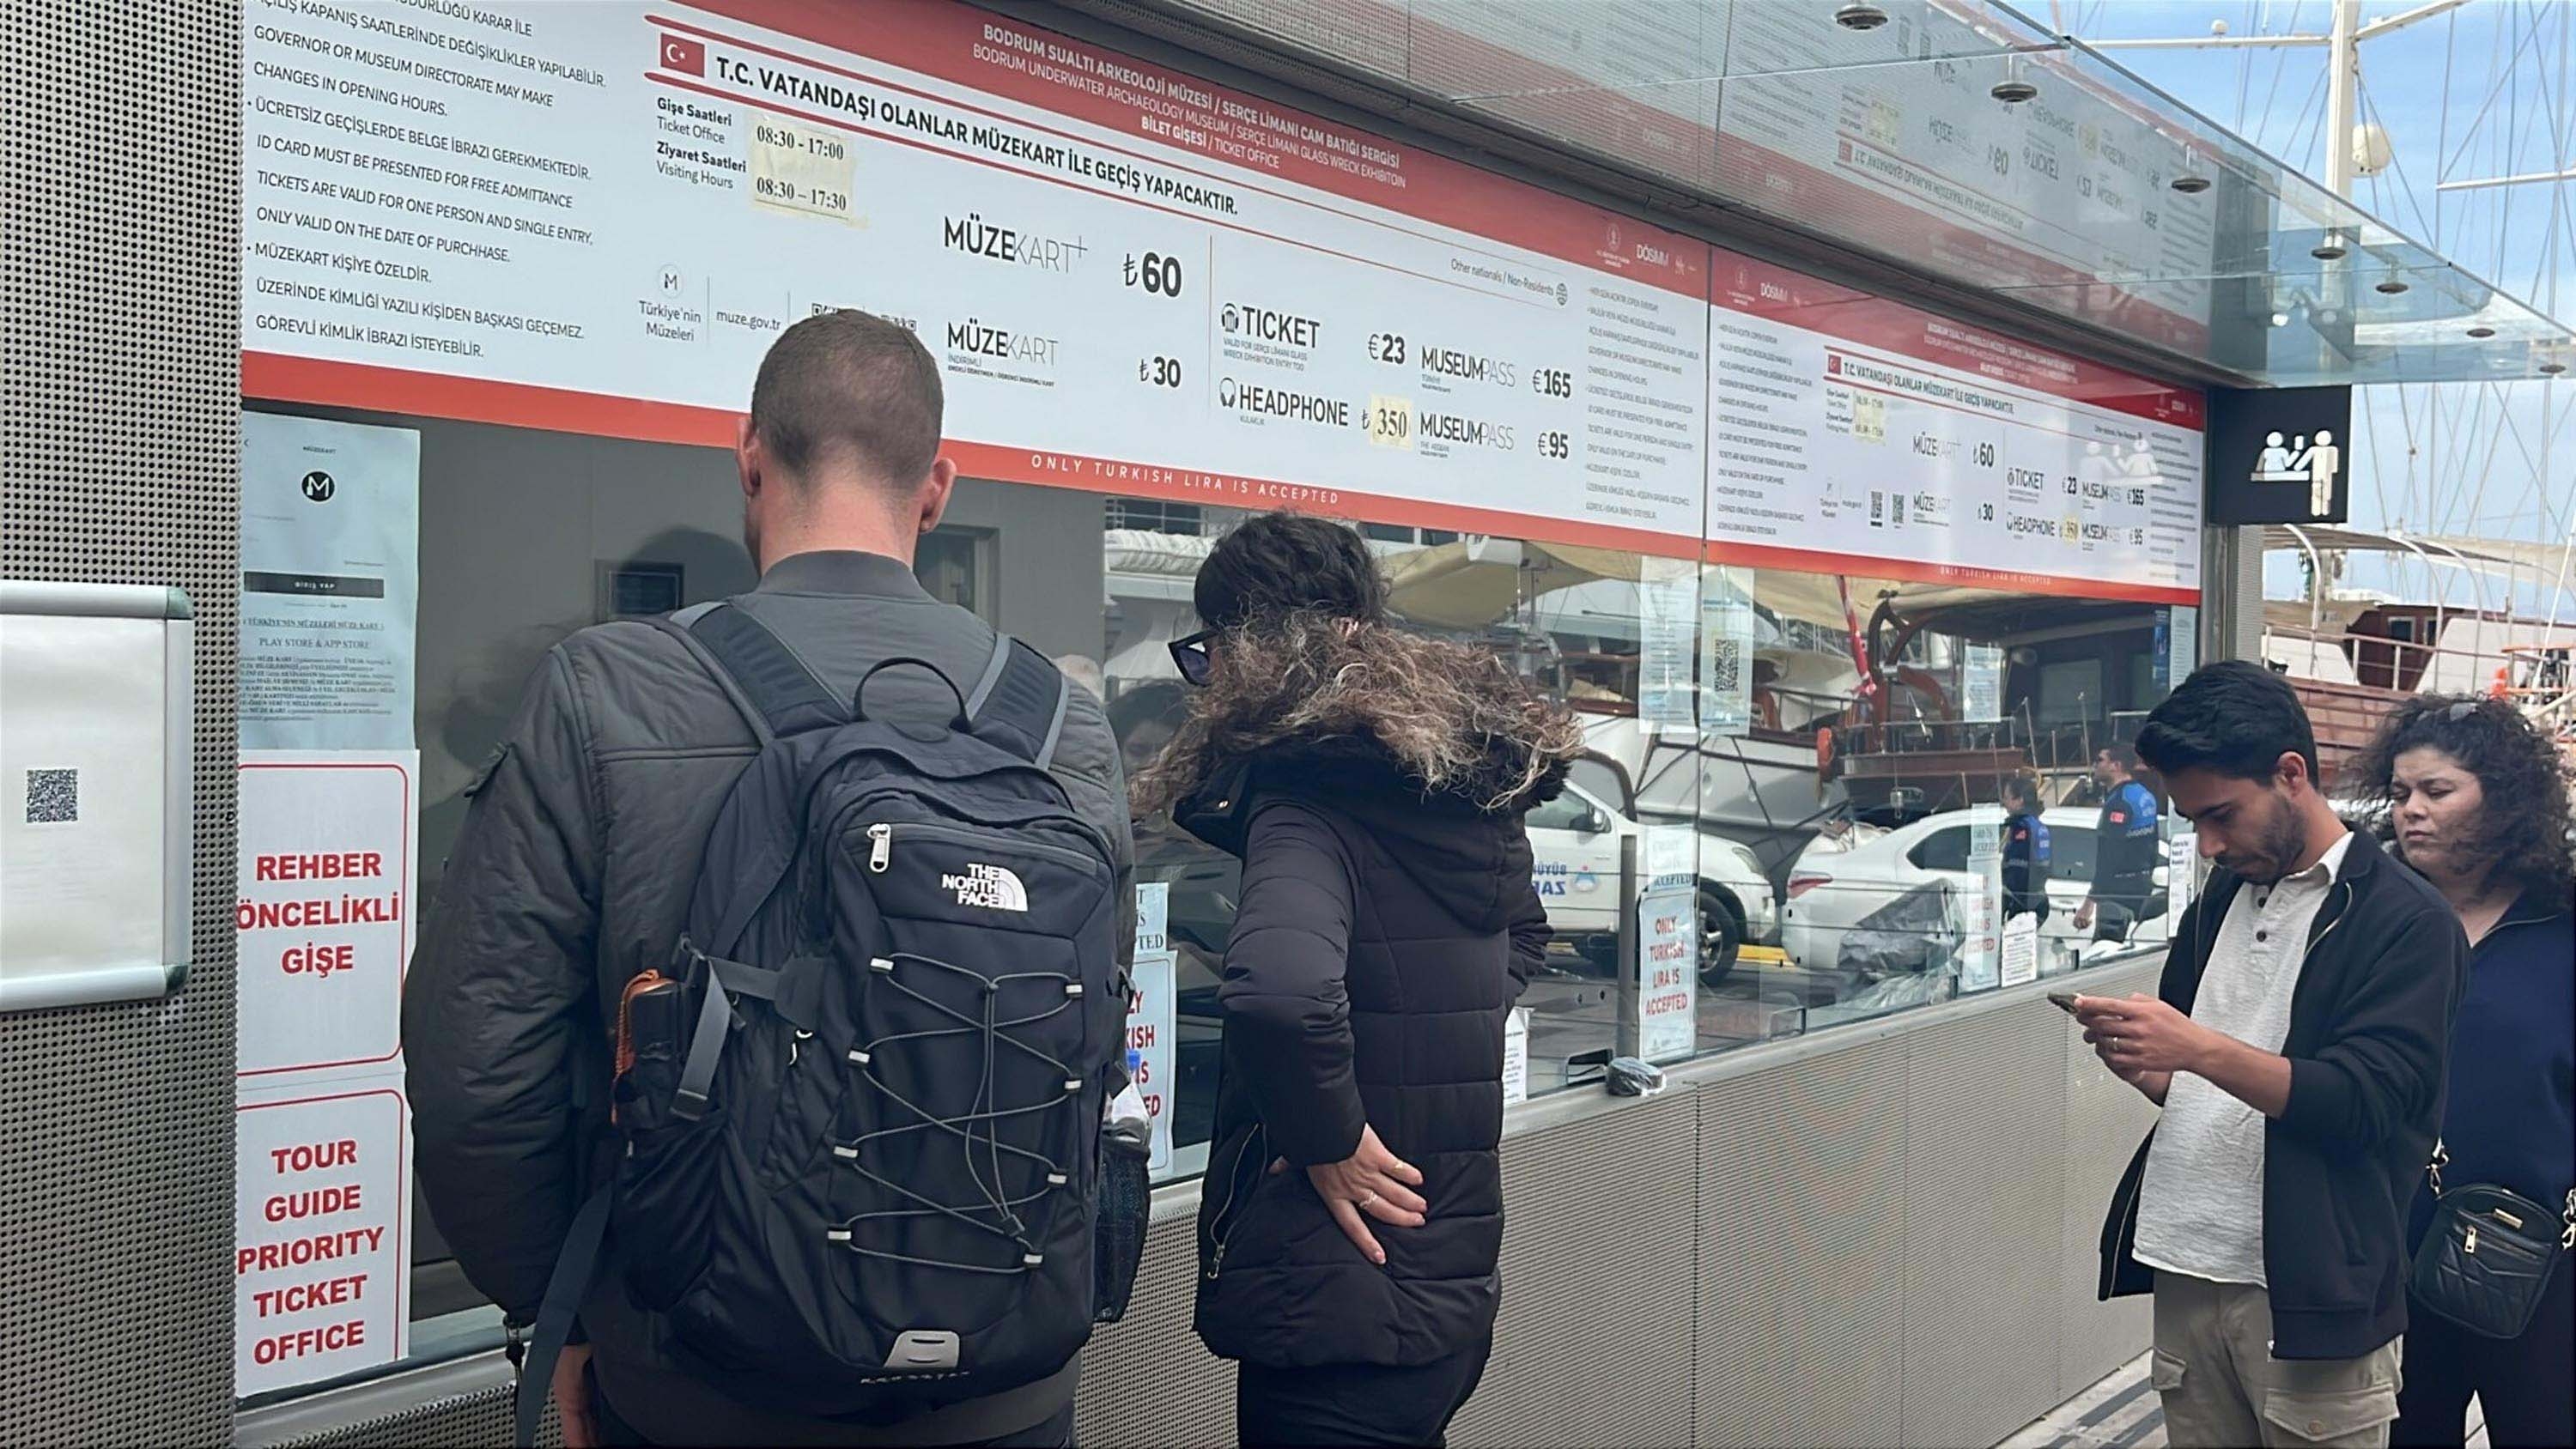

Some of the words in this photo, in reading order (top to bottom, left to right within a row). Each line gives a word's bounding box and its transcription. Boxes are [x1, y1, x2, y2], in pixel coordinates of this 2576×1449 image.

[472, 9, 512, 31] KARAR
[514, 18, 532, 37] İLE
[300, 0, 358, 28] KAPANIŞ
[360, 15, 446, 48] SAATLERİNDE
[448, 37, 536, 70] DEĞİŞİKLİKLER
[537, 59, 606, 87] YAPILABİLİR.
[253, 24, 331, 54] GOVERNOR
[332, 43, 353, 60] OR
[354, 49, 412, 73] MUSEUM
[414, 63, 494, 93] DIRECTORATE
[495, 82, 520, 98] MAY
[521, 88, 554, 106] MAKE
[252, 61, 319, 88] CHANGES
[321, 76, 337, 91] IN
[338, 80, 398, 105] OPENING
[400, 94, 447, 116] HOURS.
[983, 24, 1045, 57] BODRUM
[1047, 44, 1094, 72] SUALTI
[1095, 61, 1165, 94] ARKEOLOJİ
[1167, 82, 1212, 110] MÜZESİ
[1222, 100, 1258, 124] SERÇE
[1259, 111, 1298, 137] LİMANI
[1299, 125, 1324, 145] CAM
[1360, 144, 1400, 168] SERGİSİ
[658, 97, 683, 117] Gişe
[687, 104, 732, 126] Saatleri
[973, 43, 1026, 72] BODRUM
[1028, 61, 1105, 95] UNDERWATER
[1105, 85, 1184, 119] ARCHAEOLOGY
[1184, 109, 1229, 134] MUSEUM
[1236, 124, 1266, 146] SERÇE
[1299, 145, 1329, 165] GLASS
[1328, 155, 1359, 174] WRECK
[255, 95, 322, 124] ÜCRETSİZ
[324, 112, 405, 141] GEÇİŞLERDE
[408, 130, 448, 150] BELGE
[451, 136, 489, 159] İBRAZI
[491, 148, 591, 179] GEREKMEKTEDİR.
[657, 116, 690, 136] Ticket
[693, 124, 725, 144] Office
[715, 56, 754, 86] T.C.
[757, 68, 875, 120] VATANDAŞI
[880, 102, 968, 142] OLANLAR
[971, 126, 1065, 167] MÜZEKART
[1067, 148, 1091, 176] İLE
[1095, 161, 1140, 191] GEÇİŞ
[1143, 173, 1237, 214] YAPACAKTIR.
[756, 125, 795, 149] 08:30
[808, 137, 844, 161] 17:00
[1140, 115, 1171, 136] BİLET
[1172, 124, 1206, 147] GİŞESİ
[1213, 136, 1246, 158] TICKET
[1246, 148, 1279, 168] OFFICE
[256, 133, 271, 149] ID
[274, 137, 311, 156] CARD
[313, 145, 351, 164] MUST
[352, 153, 370, 168] BE
[371, 156, 442, 182] PRESENTED
[444, 171, 469, 188] FOR
[471, 176, 501, 194] FREE
[501, 184, 573, 208] ADMITTANCE
[656, 161, 698, 184] Visiting
[701, 173, 733, 189] Hours
[657, 141, 699, 161] Ziyaret
[702, 152, 746, 173] Saatleri
[256, 169, 309, 192] TICKETS
[310, 180, 337, 197] ARE
[338, 185, 376, 204] VALID
[377, 192, 404, 209] FOR
[405, 197, 434, 215] ONE
[434, 203, 484, 224] PERSON
[485, 213, 512, 229] AND
[513, 218, 556, 237] SINGLE
[756, 177, 795, 200] 08:30
[811, 189, 847, 211] 17:30
[256, 206, 293, 224] ONLY
[294, 212, 332, 231] VALID
[334, 220, 355, 235] ON
[356, 223, 382, 240] THE
[384, 228, 415, 246] DATE
[416, 233, 434, 248] OF
[254, 242, 330, 265] MÜZEKART
[331, 253, 372, 273] KİŞİYE
[374, 259, 432, 282] ÖZELDİR.
[1451, 258, 1470, 274] Other
[1472, 265, 1502, 284] nationals
[1508, 273, 1554, 297] Non-Residents
[256, 276, 326, 301] ÜZERİNDE
[329, 288, 379, 308] KİMLİĞİ
[380, 296, 419, 314] YAZILI
[422, 301, 471, 321] KİŞİDEN
[473, 310, 523, 330] BAŞKASI
[525, 318, 584, 338] GEÇEMEZ.
[639, 300, 702, 324] Türkiye'nin
[716, 310, 781, 331] muze.gov.tr
[255, 314, 316, 335] GÖREVLİ
[319, 321, 364, 341] KİMLİK
[367, 326, 407, 347] İBRAZI
[410, 333, 483, 356] İSTEYEBİLİR.
[646, 322, 695, 342] Müzeleri
[947, 318, 1059, 367] MÜZEKART
[1242, 306, 1320, 349] TICKET
[1368, 333, 1406, 365] €23
[1421, 345, 1516, 387] MUSEUMPASS
[1533, 369, 1571, 398] €165
[1240, 384, 1349, 427] HEADPHONE
[1377, 408, 1408, 439] 350
[1420, 411, 1515, 451] MUSEUMPASS
[1538, 431, 1570, 459] €95
[1031, 454, 1083, 473] ONLY
[1095, 462, 1173, 484] TURKISH
[1184, 473, 1222, 490] LIRA
[1234, 480, 1249, 494] IS
[1258, 483, 1339, 504] ACCEPTED
[2014, 468, 2044, 491] TICKET
[2014, 514, 2055, 537] HEADPHONE
[259, 637, 282, 646] PLAY
[285, 639, 313, 648] STORE
[256, 852, 382, 881] REHBER
[942, 874, 999, 895] NORTH
[967, 863, 1000, 881] THE
[237, 891, 399, 930] ÖNCELİKLİ
[957, 890, 1000, 909] FACE
[1656, 916, 1677, 936] ONLY
[281, 942, 354, 978] GİŞE
[1653, 970, 1670, 988] LIRA
[1671, 968, 1680, 985] IS
[1645, 992, 1687, 1016] ACCEPTED
[271, 1140, 357, 1174] TOUR
[264, 1185, 361, 1222] GUIDE
[238, 1226, 385, 1275] PRIORITY
[253, 1275, 368, 1318] TICKET
[254, 1320, 364, 1365] OFFICE
